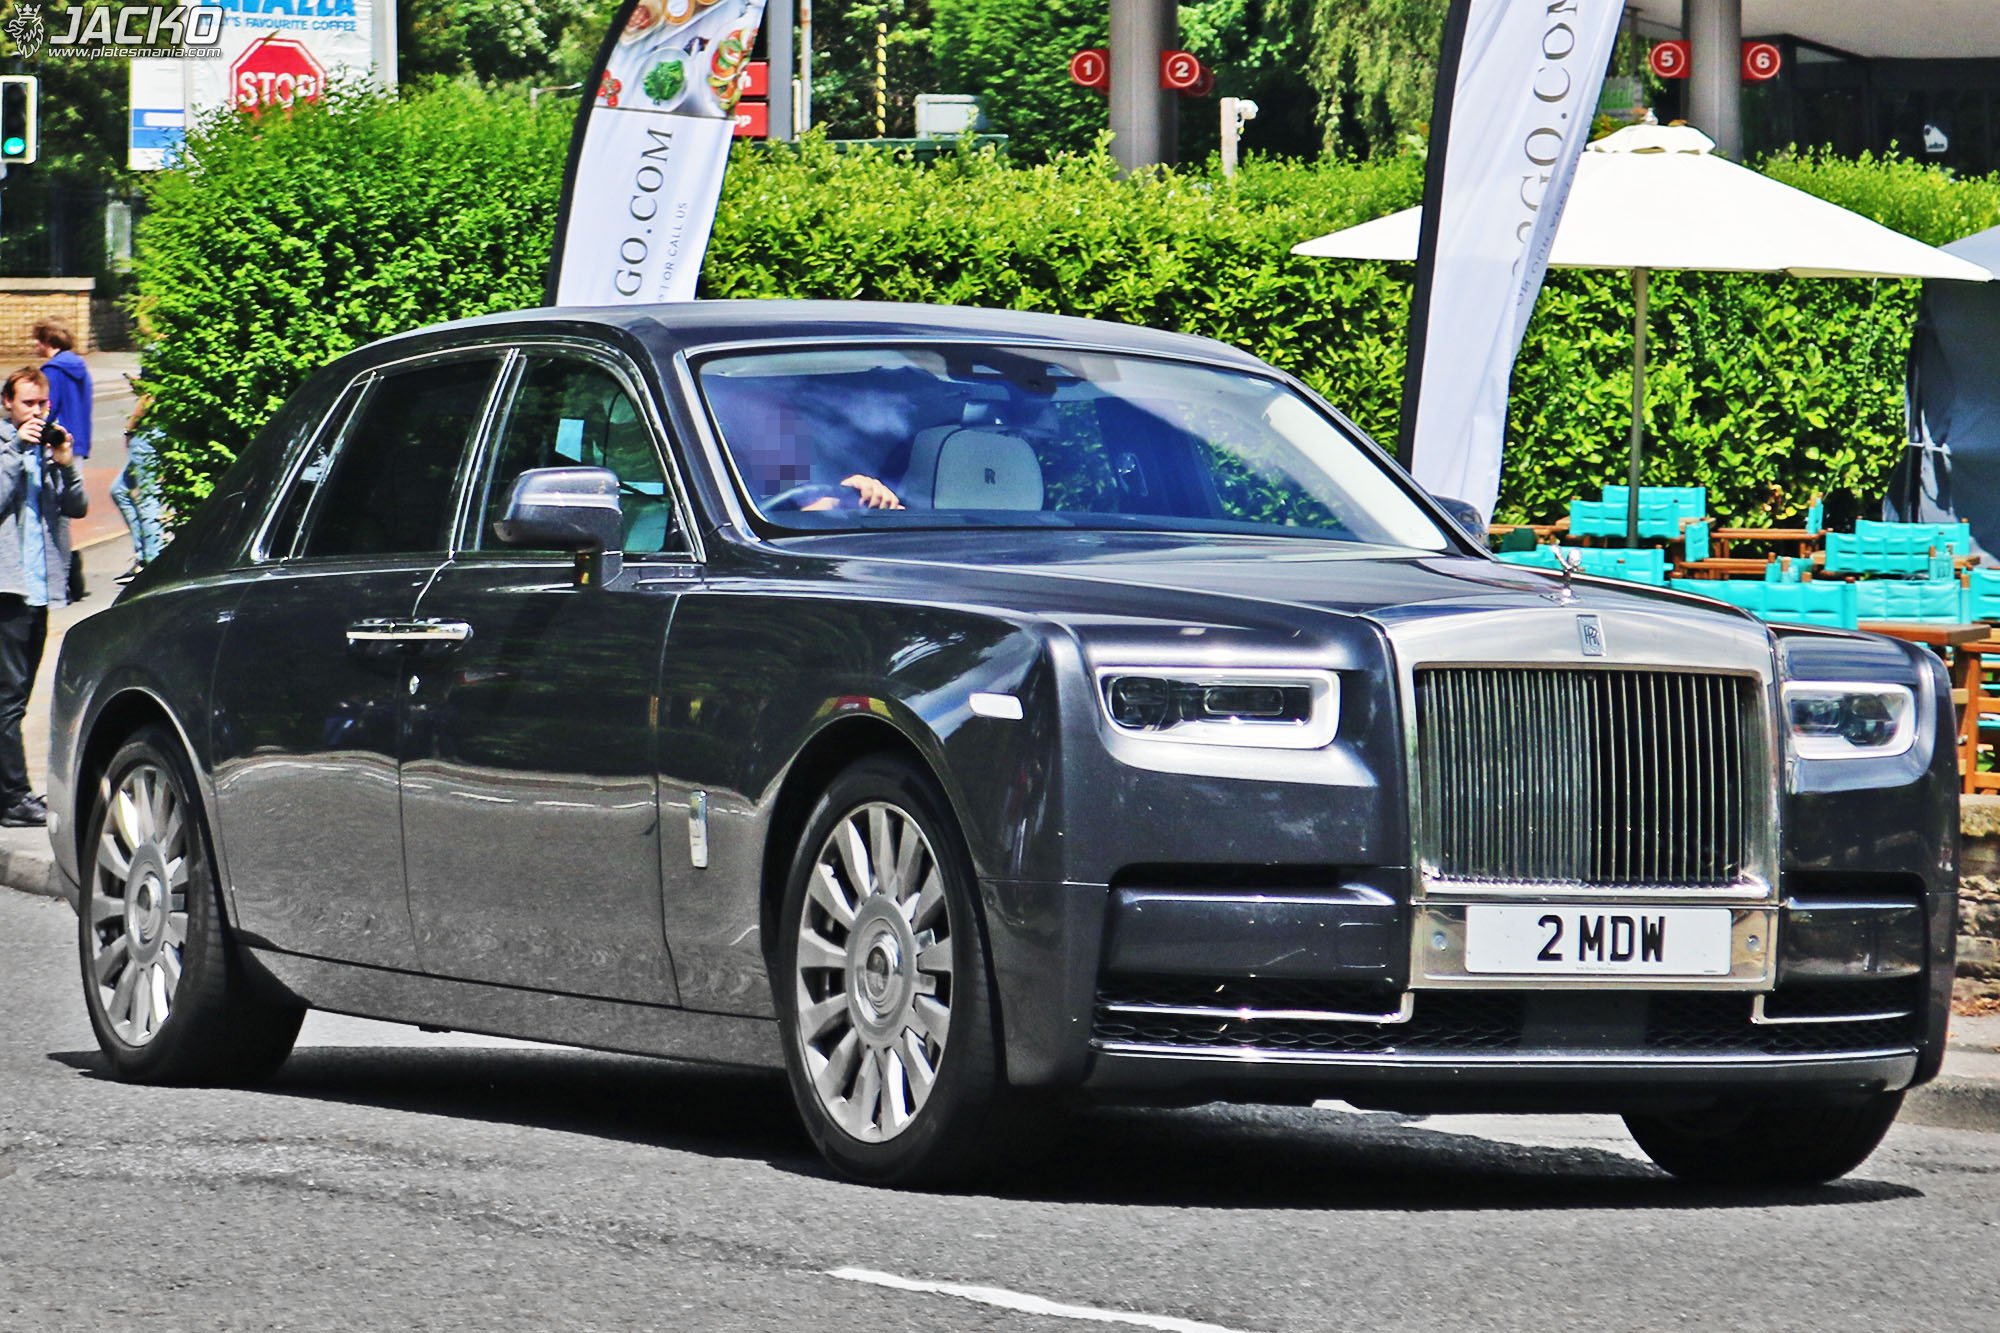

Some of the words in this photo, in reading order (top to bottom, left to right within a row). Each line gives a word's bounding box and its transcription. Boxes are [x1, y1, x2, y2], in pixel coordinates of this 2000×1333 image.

[245, 17, 309, 31] FAVOURITE
[312, 20, 357, 32] COFFEE
[1083, 60, 1093, 75] 1
[1661, 51, 1674, 67] 5
[1756, 52, 1770, 69] 6
[1175, 61, 1189, 77] 2
[238, 71, 316, 109] STOP
[614, 128, 673, 297] GO.COM
[676, 203, 687, 219] US
[668, 227, 682, 257] CALL
[663, 262, 675, 280] OR
[1537, 914, 1564, 961] 2
[1579, 915, 1666, 962] MDW
